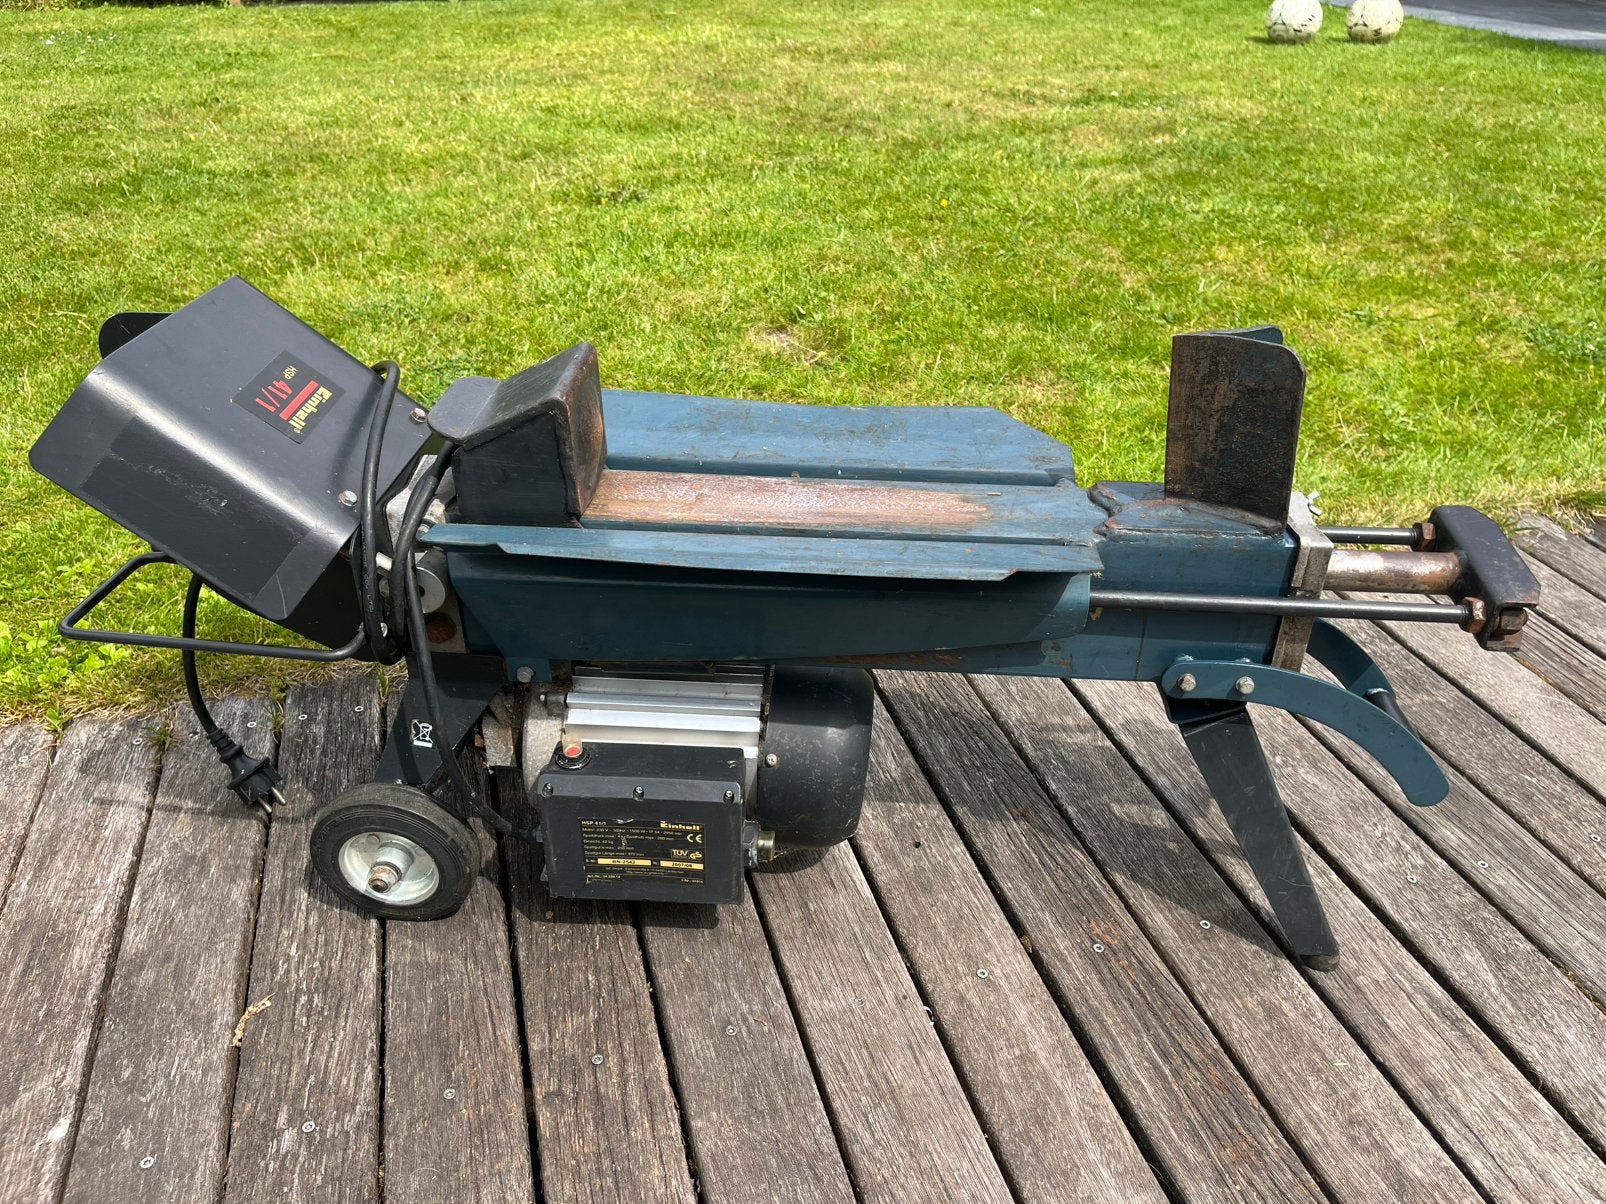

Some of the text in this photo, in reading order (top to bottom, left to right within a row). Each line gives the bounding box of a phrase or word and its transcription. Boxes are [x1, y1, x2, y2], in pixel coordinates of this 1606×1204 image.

[256, 365, 299, 413] HSP 41/1
[289, 386, 333, 430] Einhell
[660, 821, 700, 831] Einhell
[687, 833, 703, 844] CE
